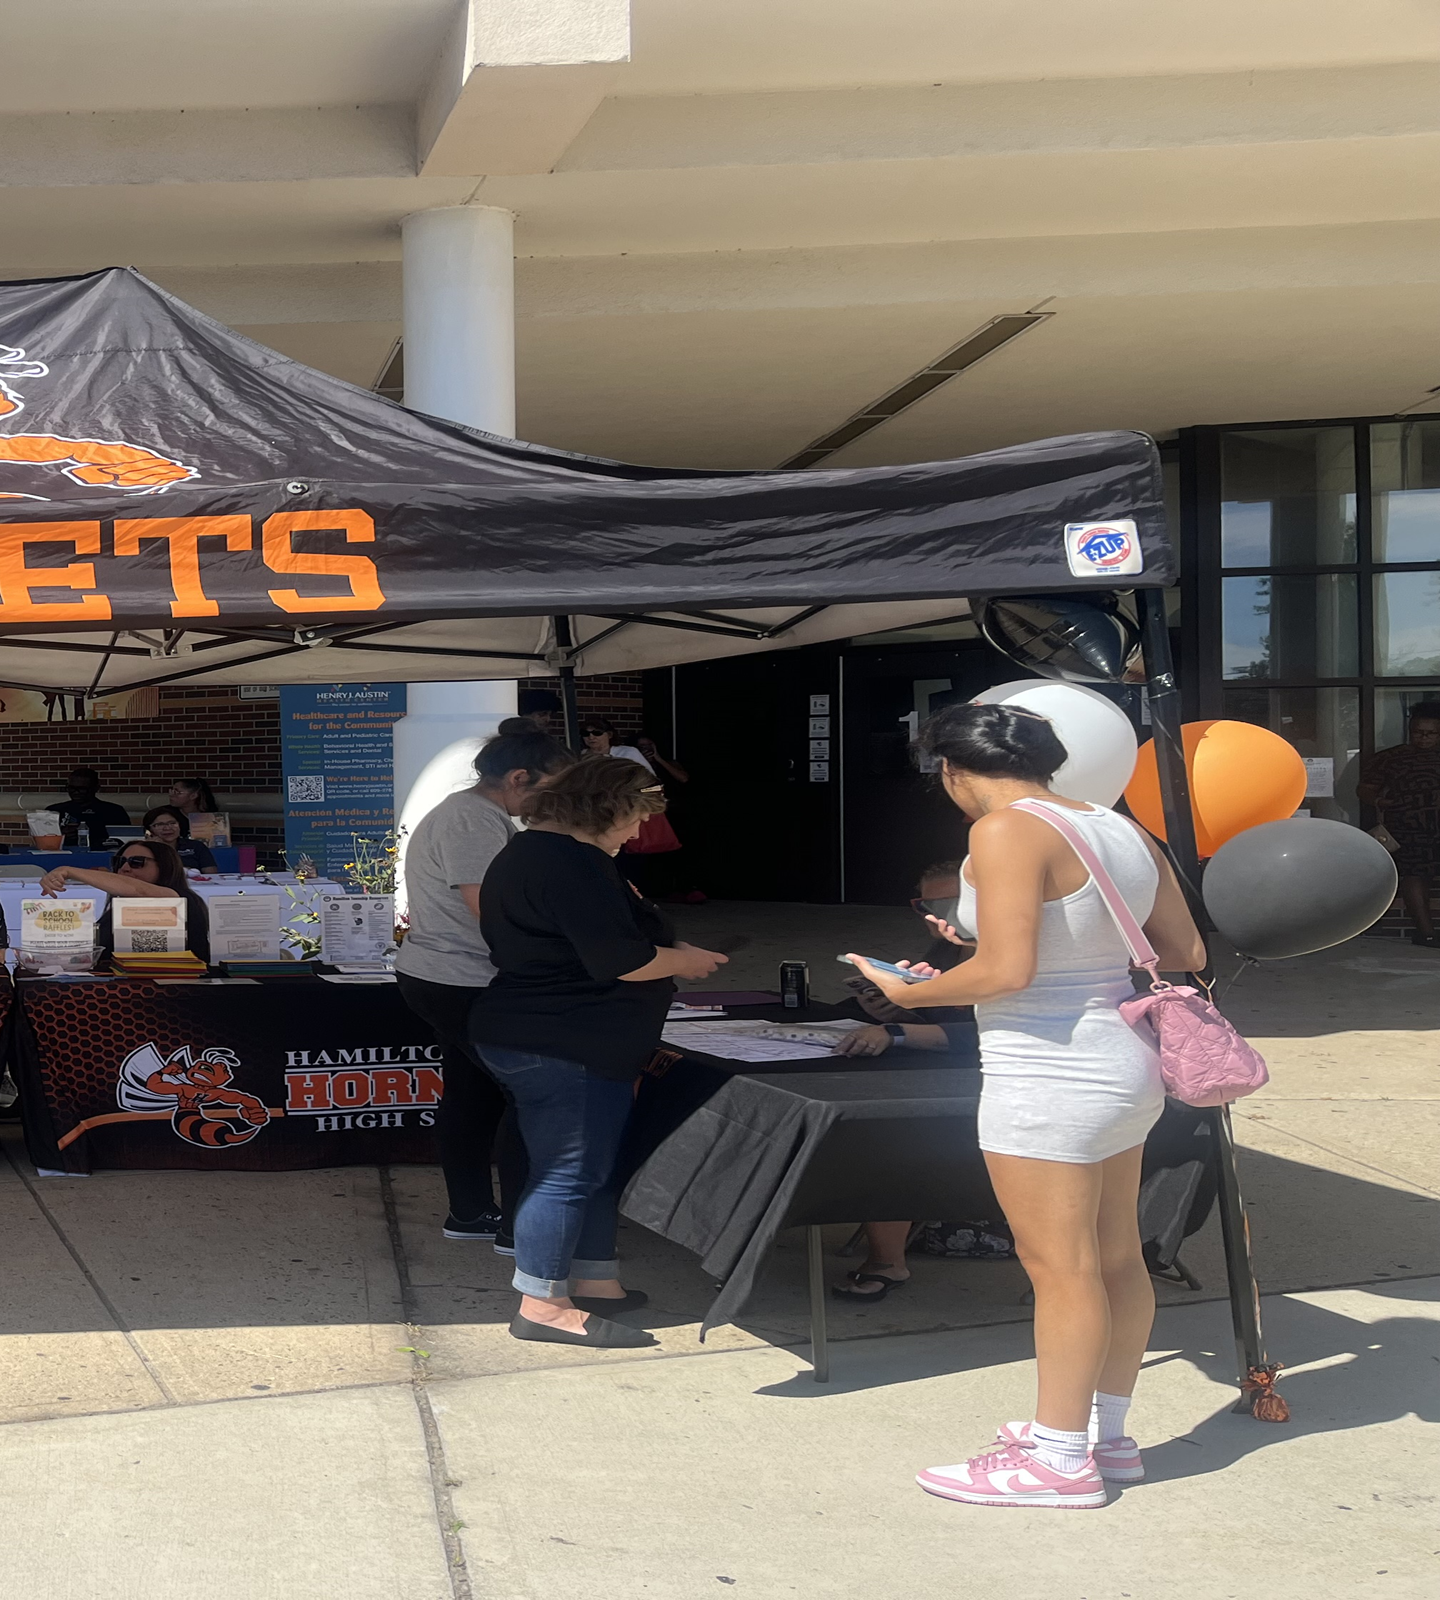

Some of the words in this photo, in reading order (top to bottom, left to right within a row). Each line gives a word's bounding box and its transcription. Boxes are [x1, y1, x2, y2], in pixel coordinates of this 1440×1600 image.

[292, 712, 345, 720] Healthcare
[347, 711, 365, 719] and
[309, 722, 324, 730] for
[326, 722, 342, 730] the
[345, 721, 394, 729] Communit
[288, 809, 332, 817] Atención
[335, 808, 370, 816] Médica
[311, 820, 334, 829] para
[285, 1044, 444, 1066] HAMILTO
[284, 1068, 444, 1111] HORN
[315, 1112, 405, 1132] HIGH
